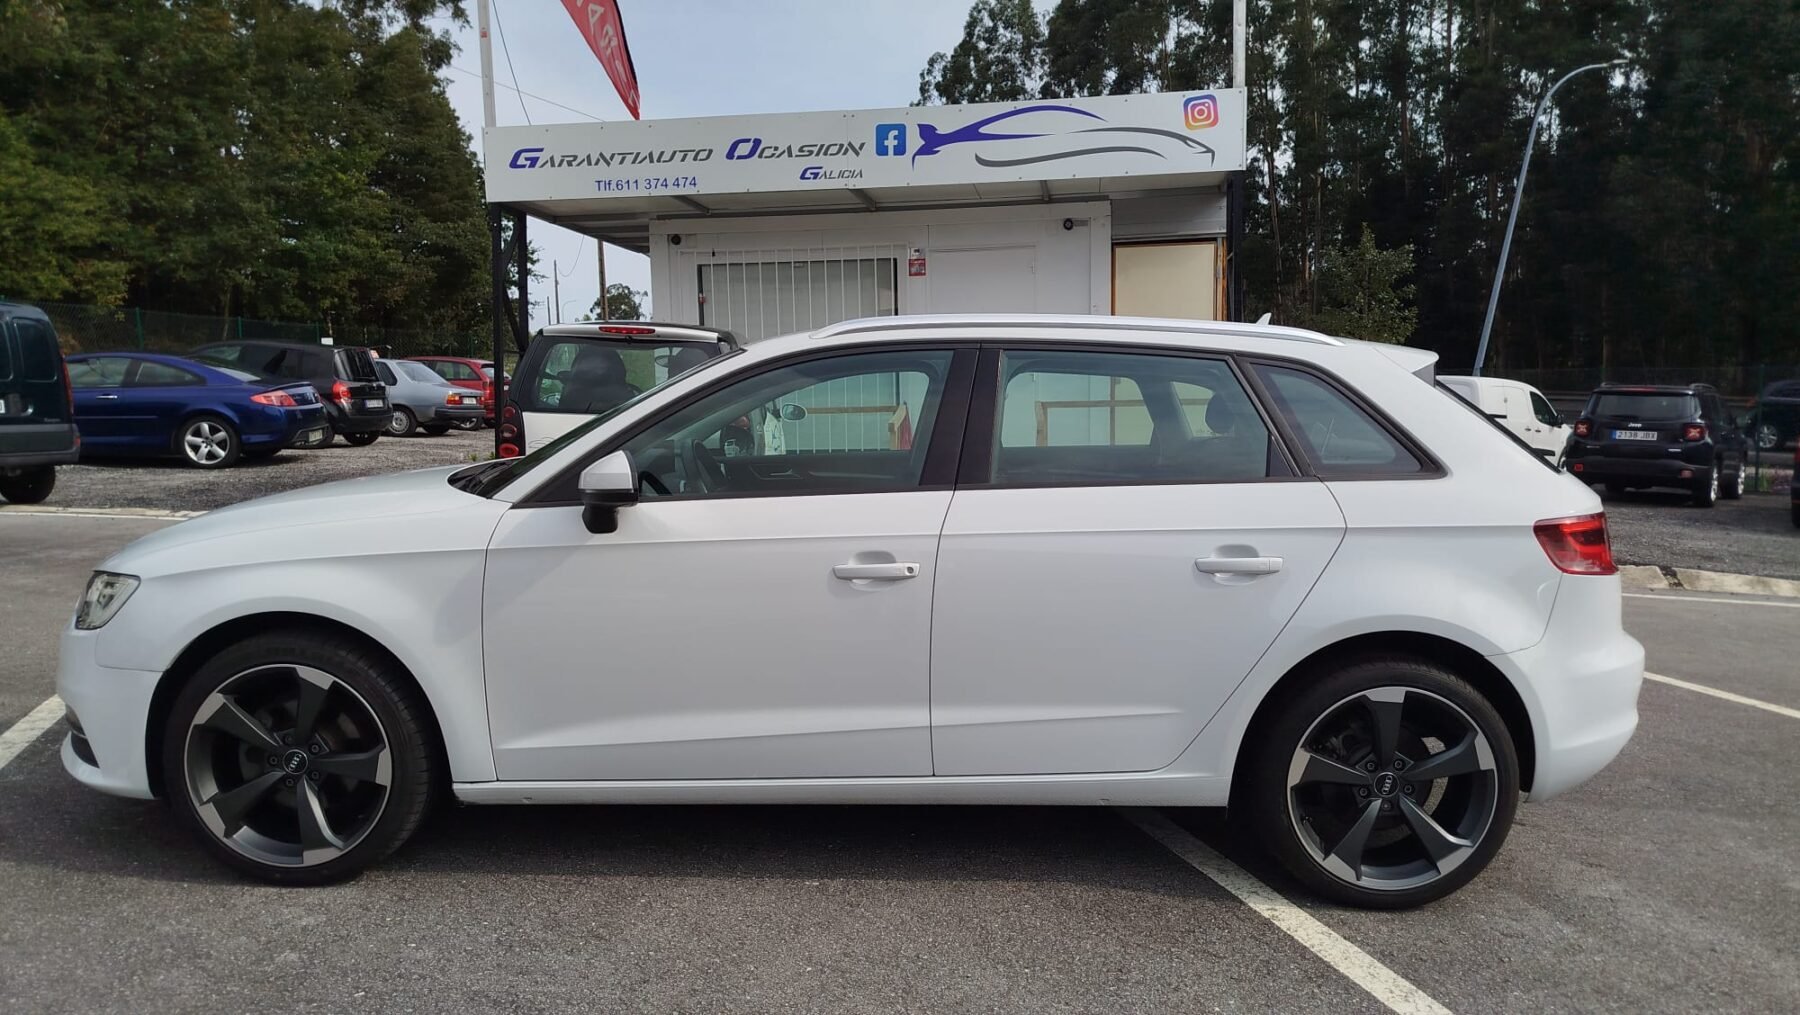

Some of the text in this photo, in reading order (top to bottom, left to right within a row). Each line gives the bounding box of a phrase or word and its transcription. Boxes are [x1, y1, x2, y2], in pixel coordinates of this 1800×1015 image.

[508, 137, 866, 169] GARANTIAUTO OCASION
[799, 166, 863, 180] GALICIA
[595, 176, 697, 192] Tlf.611 374 474
